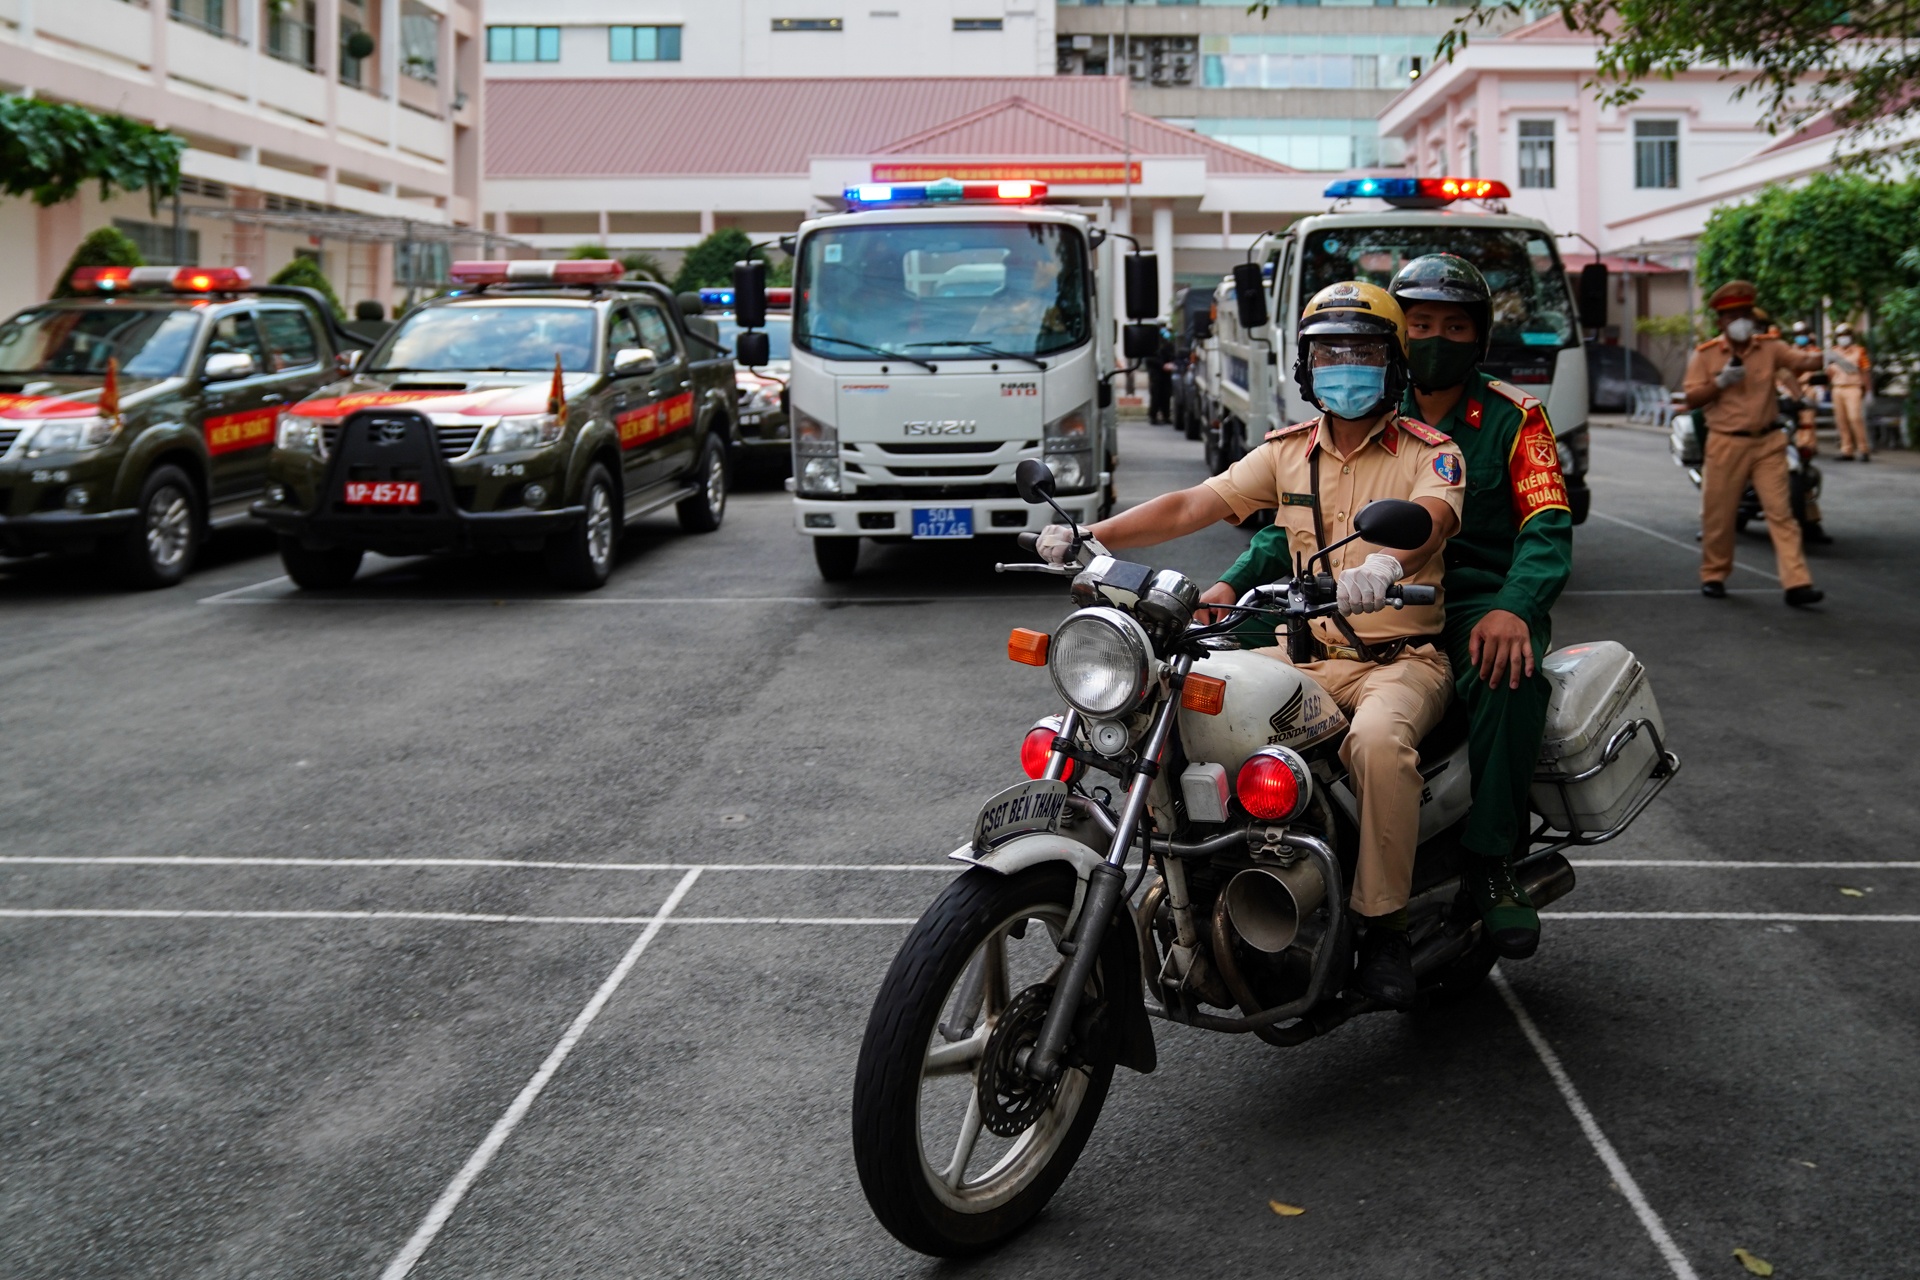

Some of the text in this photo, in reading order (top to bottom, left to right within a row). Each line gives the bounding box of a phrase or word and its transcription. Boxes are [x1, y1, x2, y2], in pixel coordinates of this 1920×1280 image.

[1000, 381, 1036, 389] NMR
[902, 419, 976, 436] ISUZU
[1517, 470, 1550, 493] KIỂM
[1526, 486, 1562, 507] QUÂN
[928, 508, 956, 522] 50A
[1267, 725, 1307, 745] HONDA
[1306, 718, 1329, 739] TRAFFIC
[981, 801, 1010, 835] CSGT
[1008, 785, 1033, 825] BẾN
